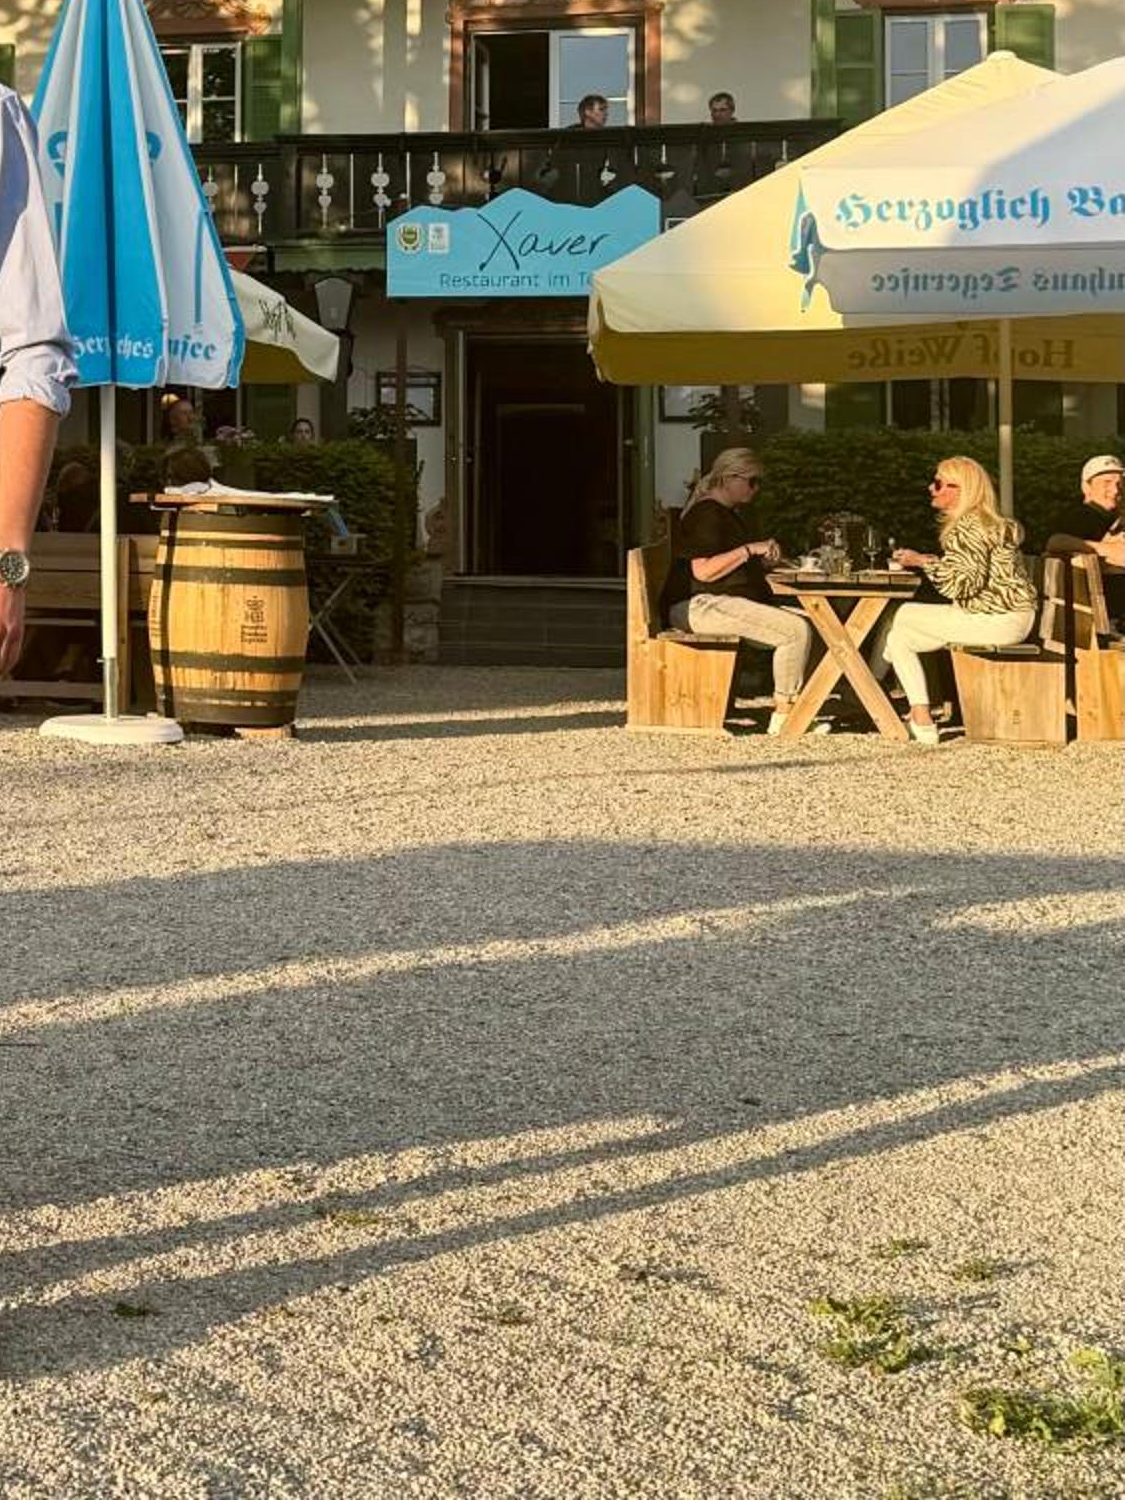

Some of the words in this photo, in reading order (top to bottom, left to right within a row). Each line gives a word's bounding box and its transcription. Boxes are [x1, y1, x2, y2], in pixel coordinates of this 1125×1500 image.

[835, 189, 1051, 231] Herzoglich
[477, 210, 608, 271] Xaver
[440, 272, 540, 288] Restaurant
[548, 271, 571, 287] im
